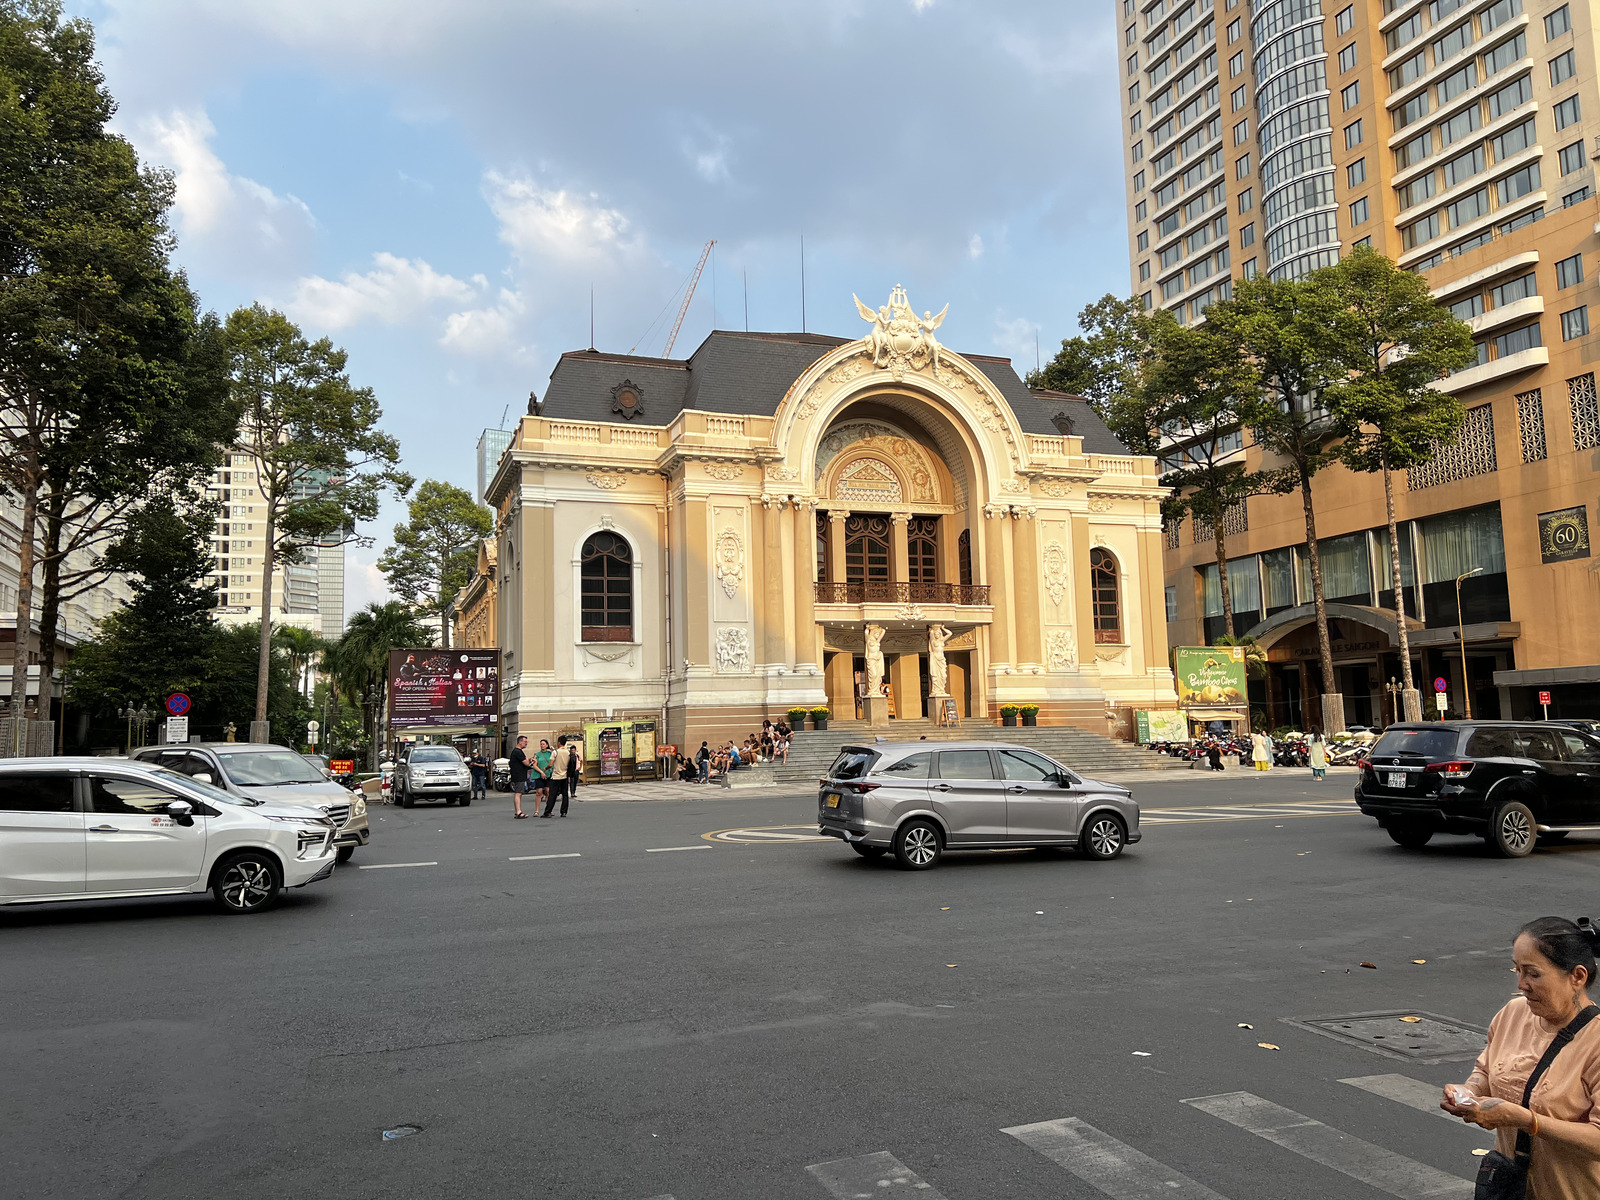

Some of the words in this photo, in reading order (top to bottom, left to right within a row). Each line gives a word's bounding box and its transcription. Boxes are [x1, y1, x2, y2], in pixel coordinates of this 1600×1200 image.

[1556, 526, 1575, 544] 60
[1344, 641, 1379, 651] SAIGON
[394, 677, 424, 689] Spanish
[428, 677, 453, 686] Italian
[1187, 673, 1220, 687] Bamboo
[1220, 675, 1238, 686] Circus
